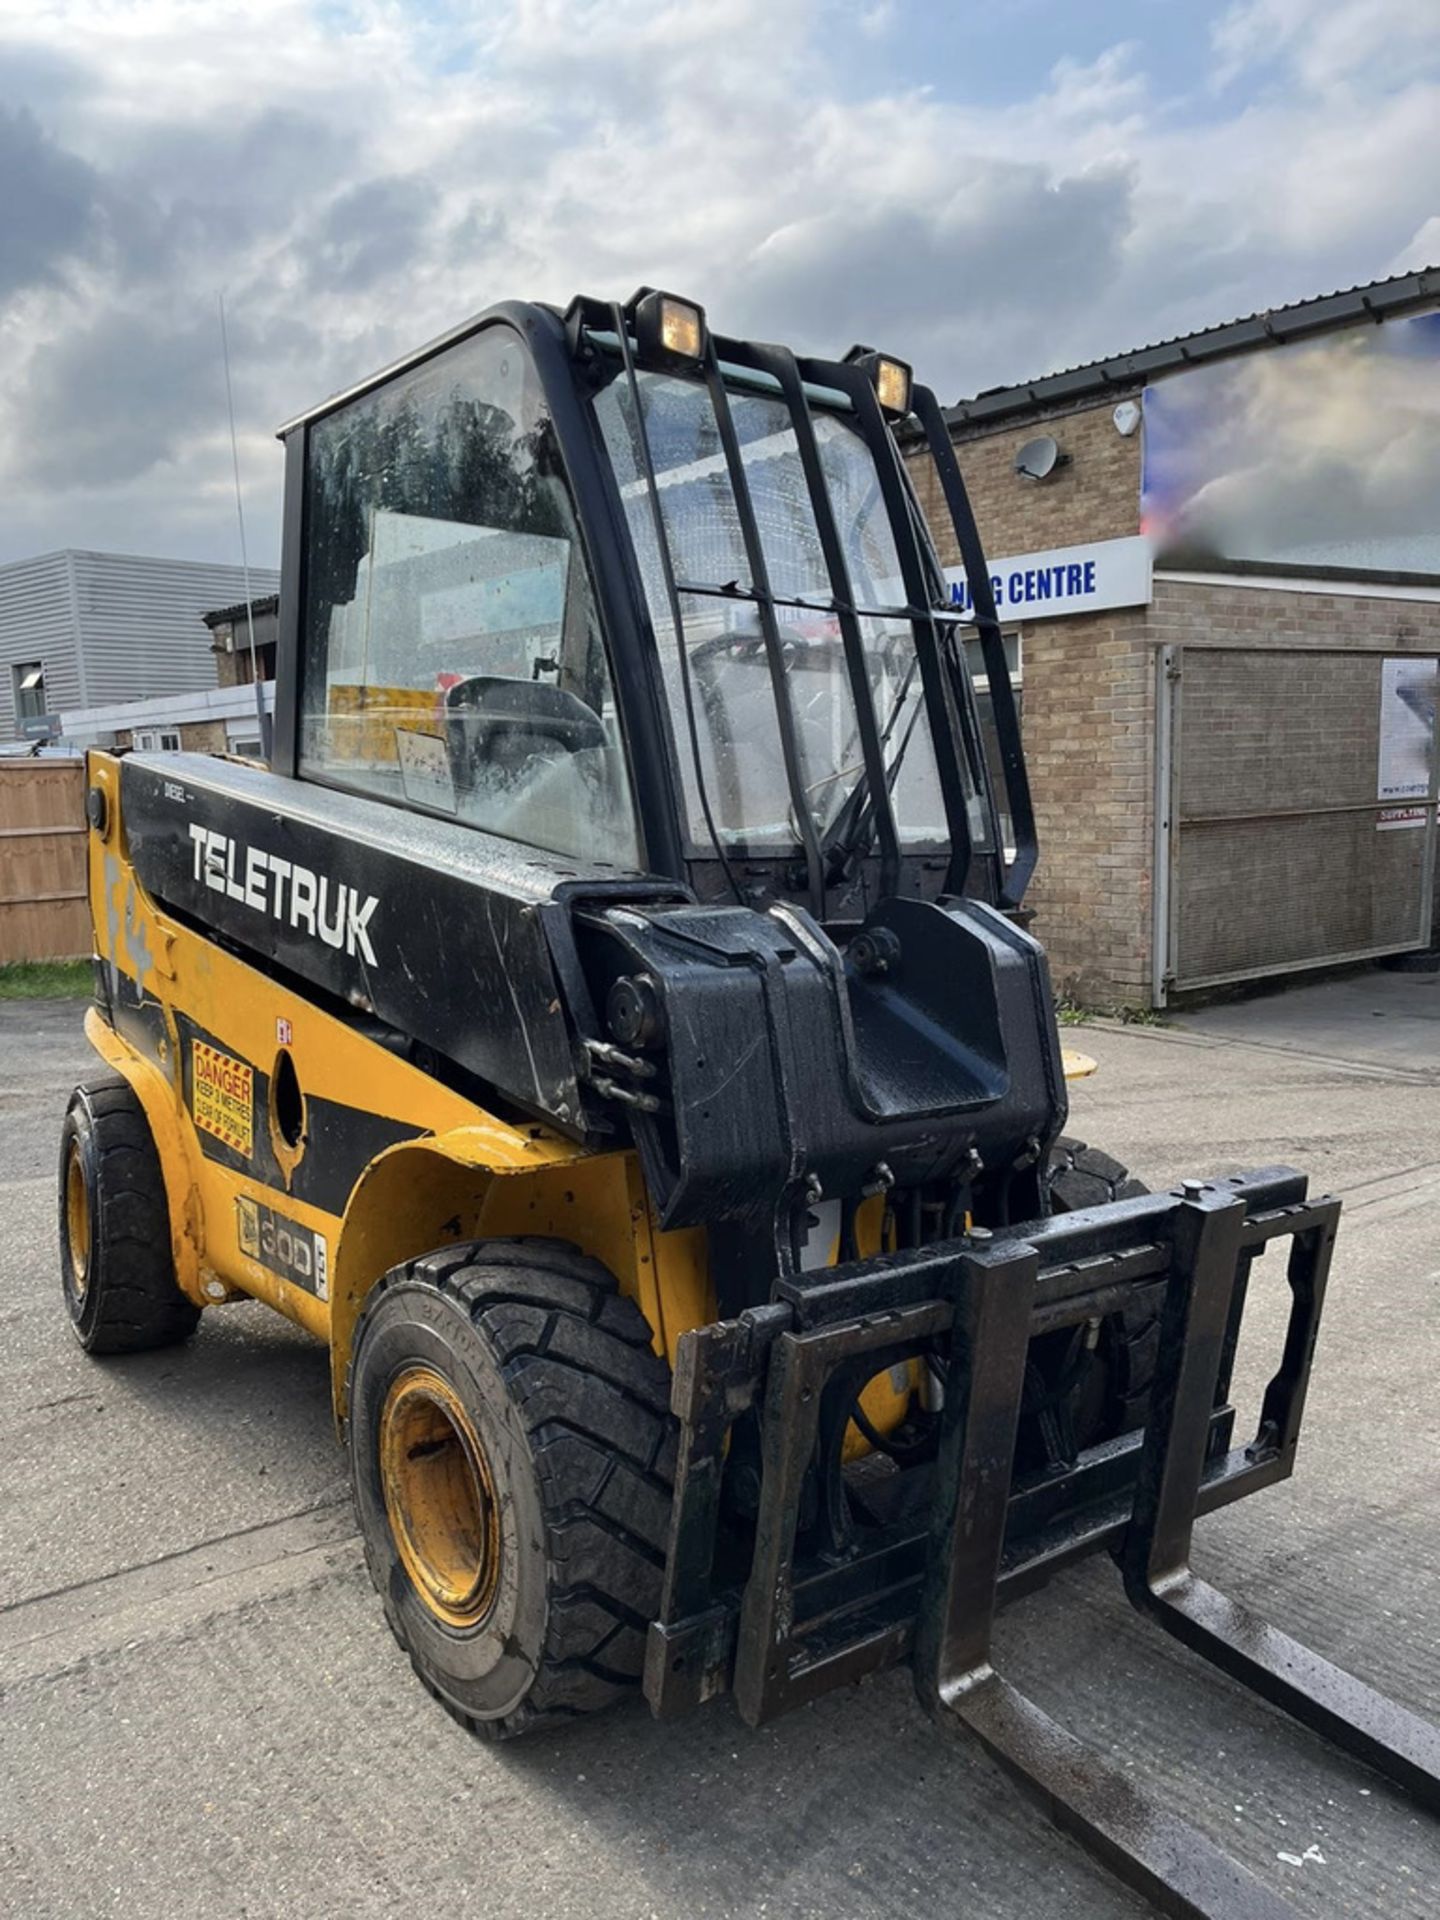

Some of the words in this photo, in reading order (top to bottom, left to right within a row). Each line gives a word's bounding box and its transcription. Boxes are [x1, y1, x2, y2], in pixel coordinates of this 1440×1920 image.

[1008, 561, 1096, 604] CENTRE
[189, 823, 379, 968] TELETRUK
[196, 1055, 250, 1104] DANGER
[196, 1081, 214, 1098] KEEP
[221, 1092, 250, 1122] METRES
[262, 1220, 312, 1277] 30D
